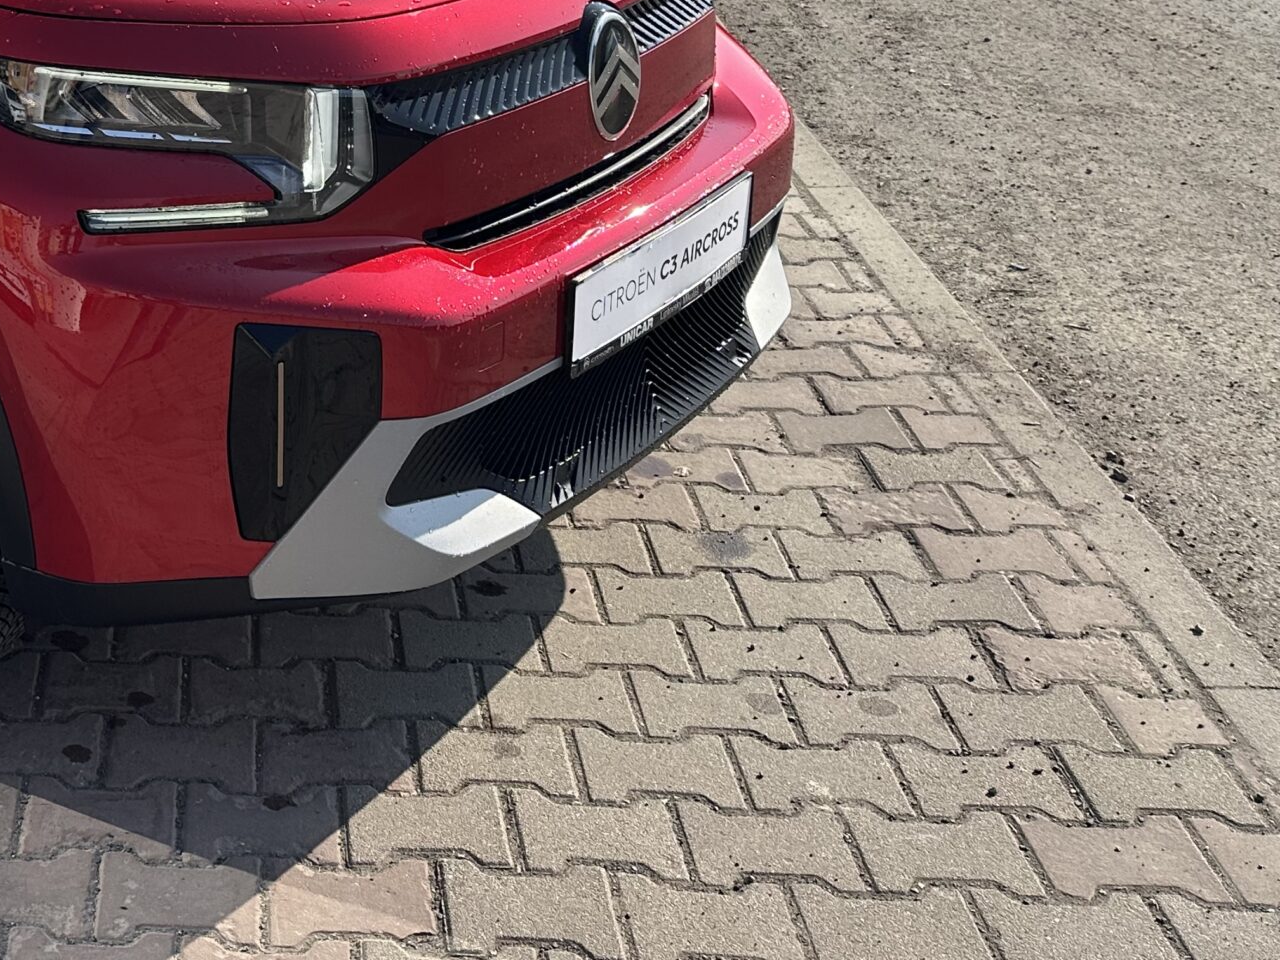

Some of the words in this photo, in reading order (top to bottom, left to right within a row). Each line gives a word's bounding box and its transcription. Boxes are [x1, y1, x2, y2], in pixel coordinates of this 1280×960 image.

[591, 266, 656, 322] CITROËN
[660, 254, 678, 280] C3
[680, 210, 740, 269] AIRCROSS
[620, 317, 654, 347] UNICAR
